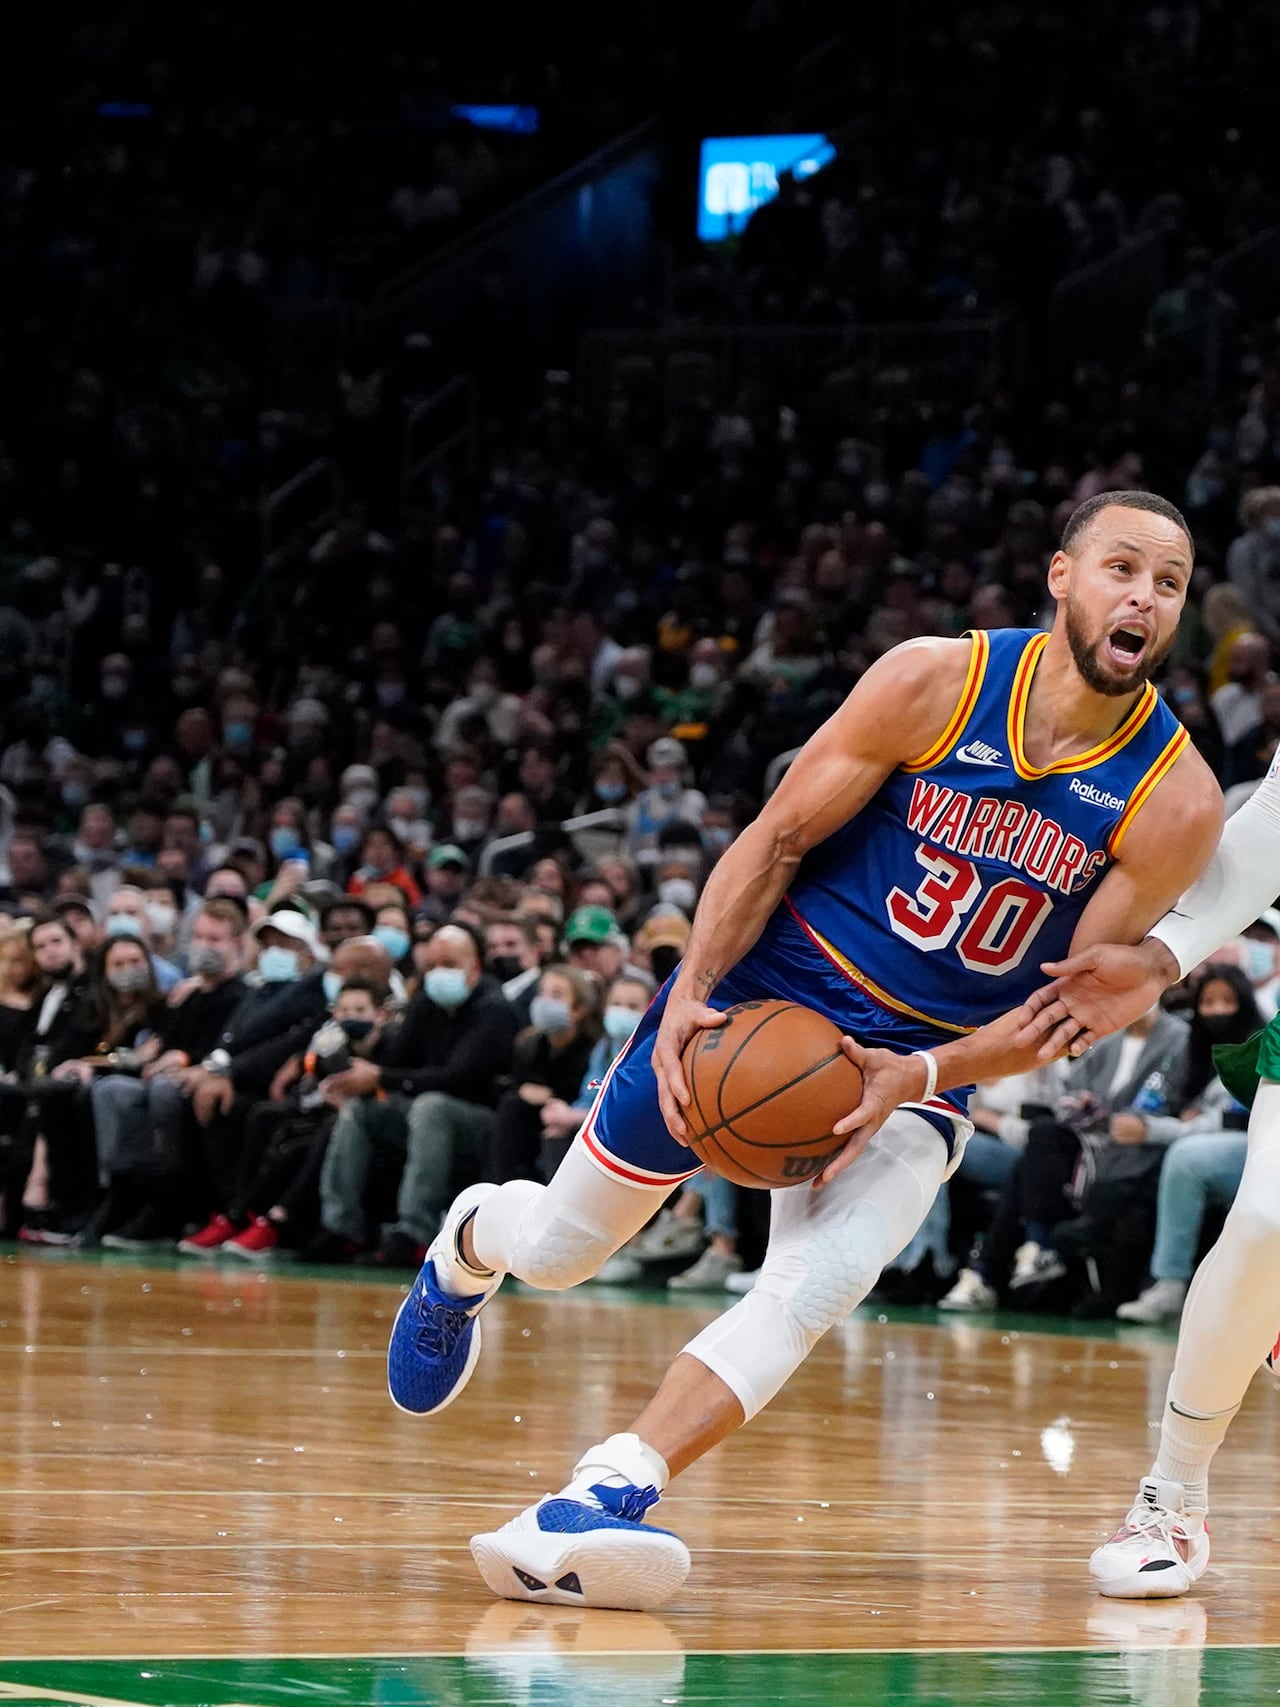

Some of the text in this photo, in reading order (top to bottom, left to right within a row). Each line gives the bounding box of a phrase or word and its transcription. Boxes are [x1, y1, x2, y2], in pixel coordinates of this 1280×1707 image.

[906, 777, 1107, 896] WARRIORS
[1068, 777, 1126, 812] Rakuten
[886, 841, 1054, 976] 30
